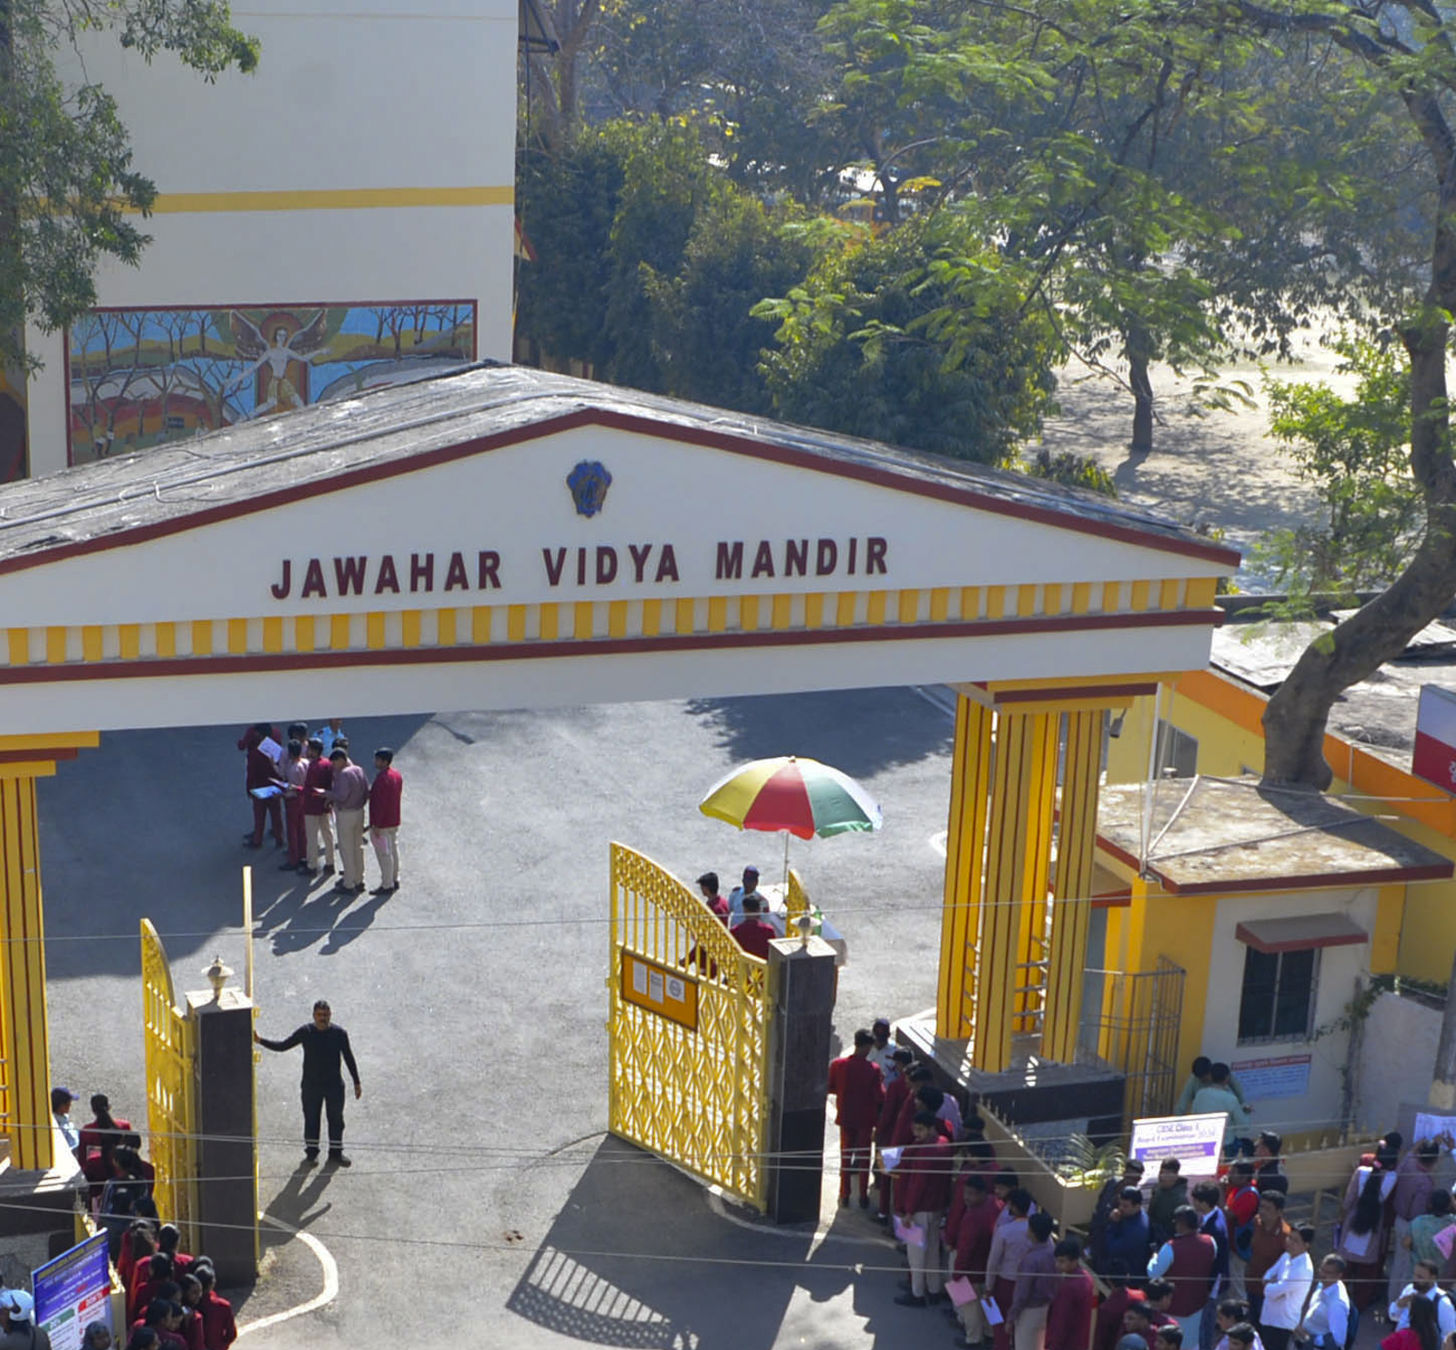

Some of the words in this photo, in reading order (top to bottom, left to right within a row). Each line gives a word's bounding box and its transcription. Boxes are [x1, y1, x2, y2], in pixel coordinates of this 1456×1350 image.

[271, 551, 501, 600] JAWAHAR
[543, 543, 680, 587] VIDYA
[715, 537, 889, 580] MANDIR
